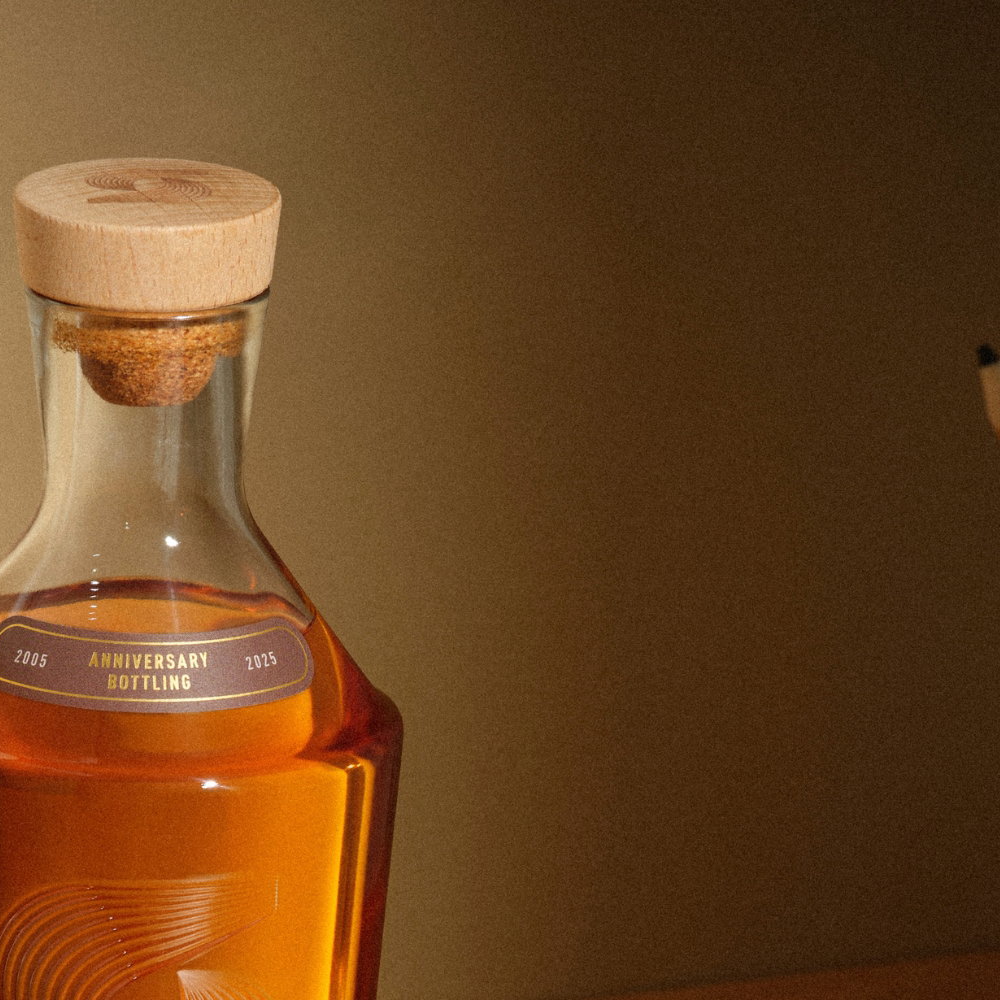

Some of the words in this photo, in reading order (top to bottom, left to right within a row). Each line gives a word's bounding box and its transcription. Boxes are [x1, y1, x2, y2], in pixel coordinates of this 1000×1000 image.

[14, 649, 48, 668] 2005
[88, 651, 209, 670] ANNIVERSARY
[245, 651, 278, 671] 2025
[107, 674, 192, 691] BOTTLING
